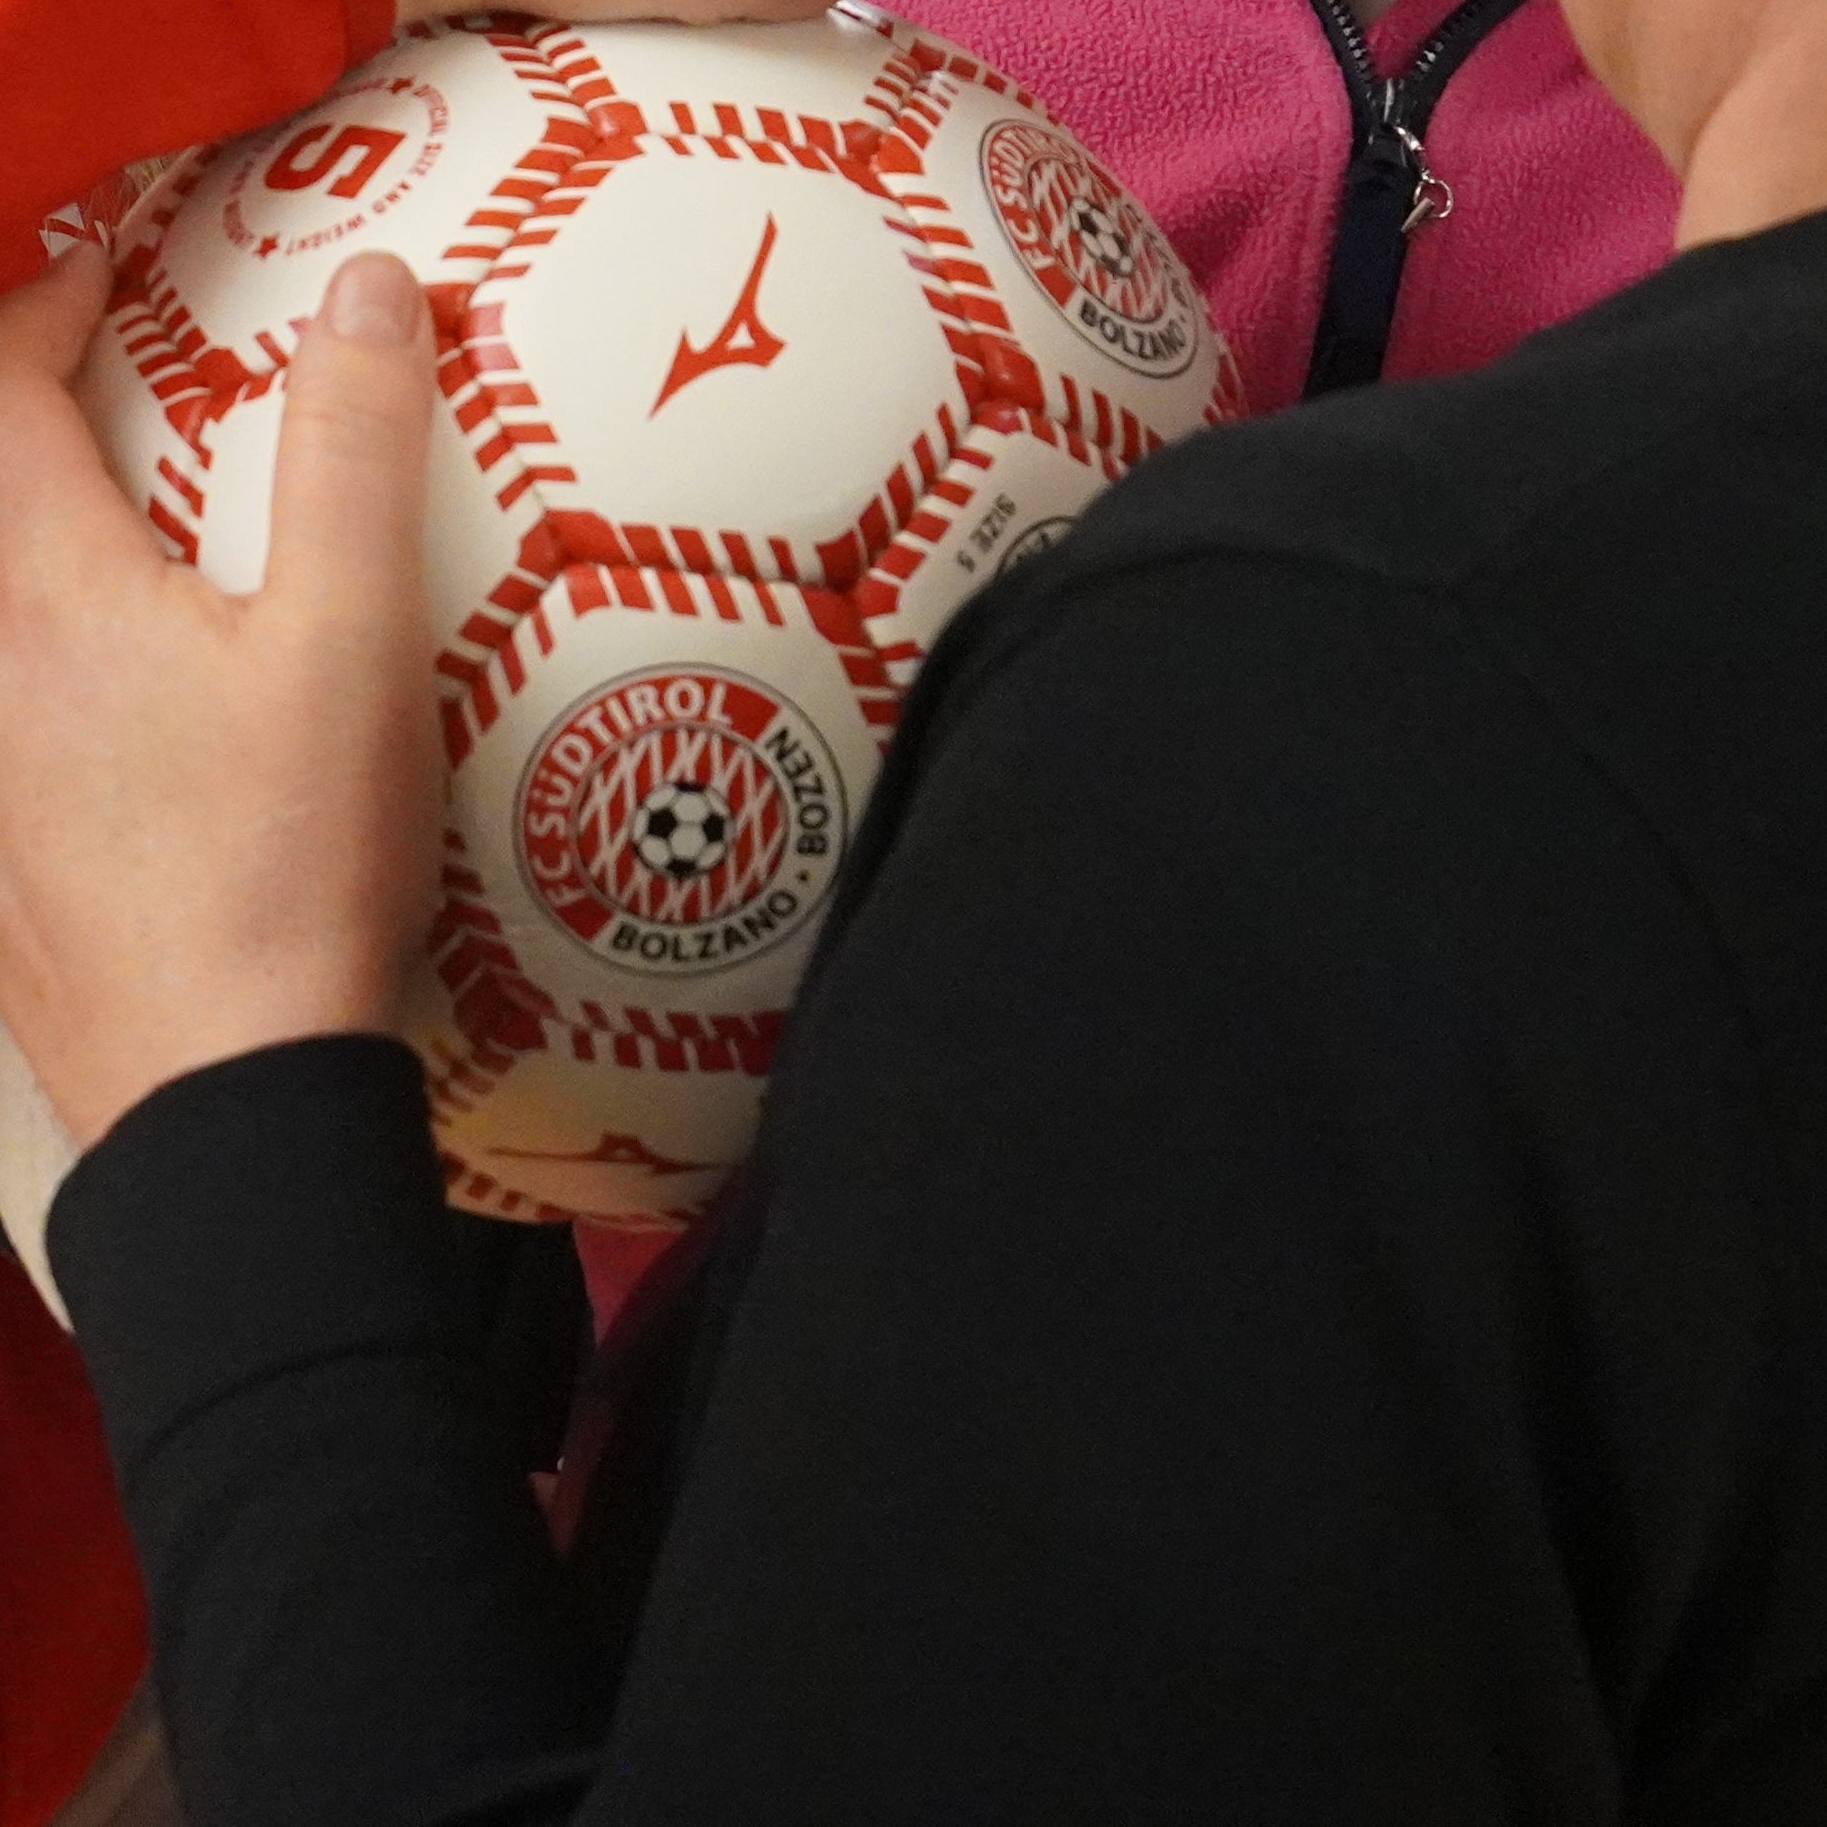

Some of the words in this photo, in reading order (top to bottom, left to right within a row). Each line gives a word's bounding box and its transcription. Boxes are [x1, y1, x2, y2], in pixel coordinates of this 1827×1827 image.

[529, 677, 734, 839] SÜDTIROL
[533, 851, 587, 908] FC
[611, 889, 798, 962] BOLZANO
[765, 727, 830, 856] BOZEN
